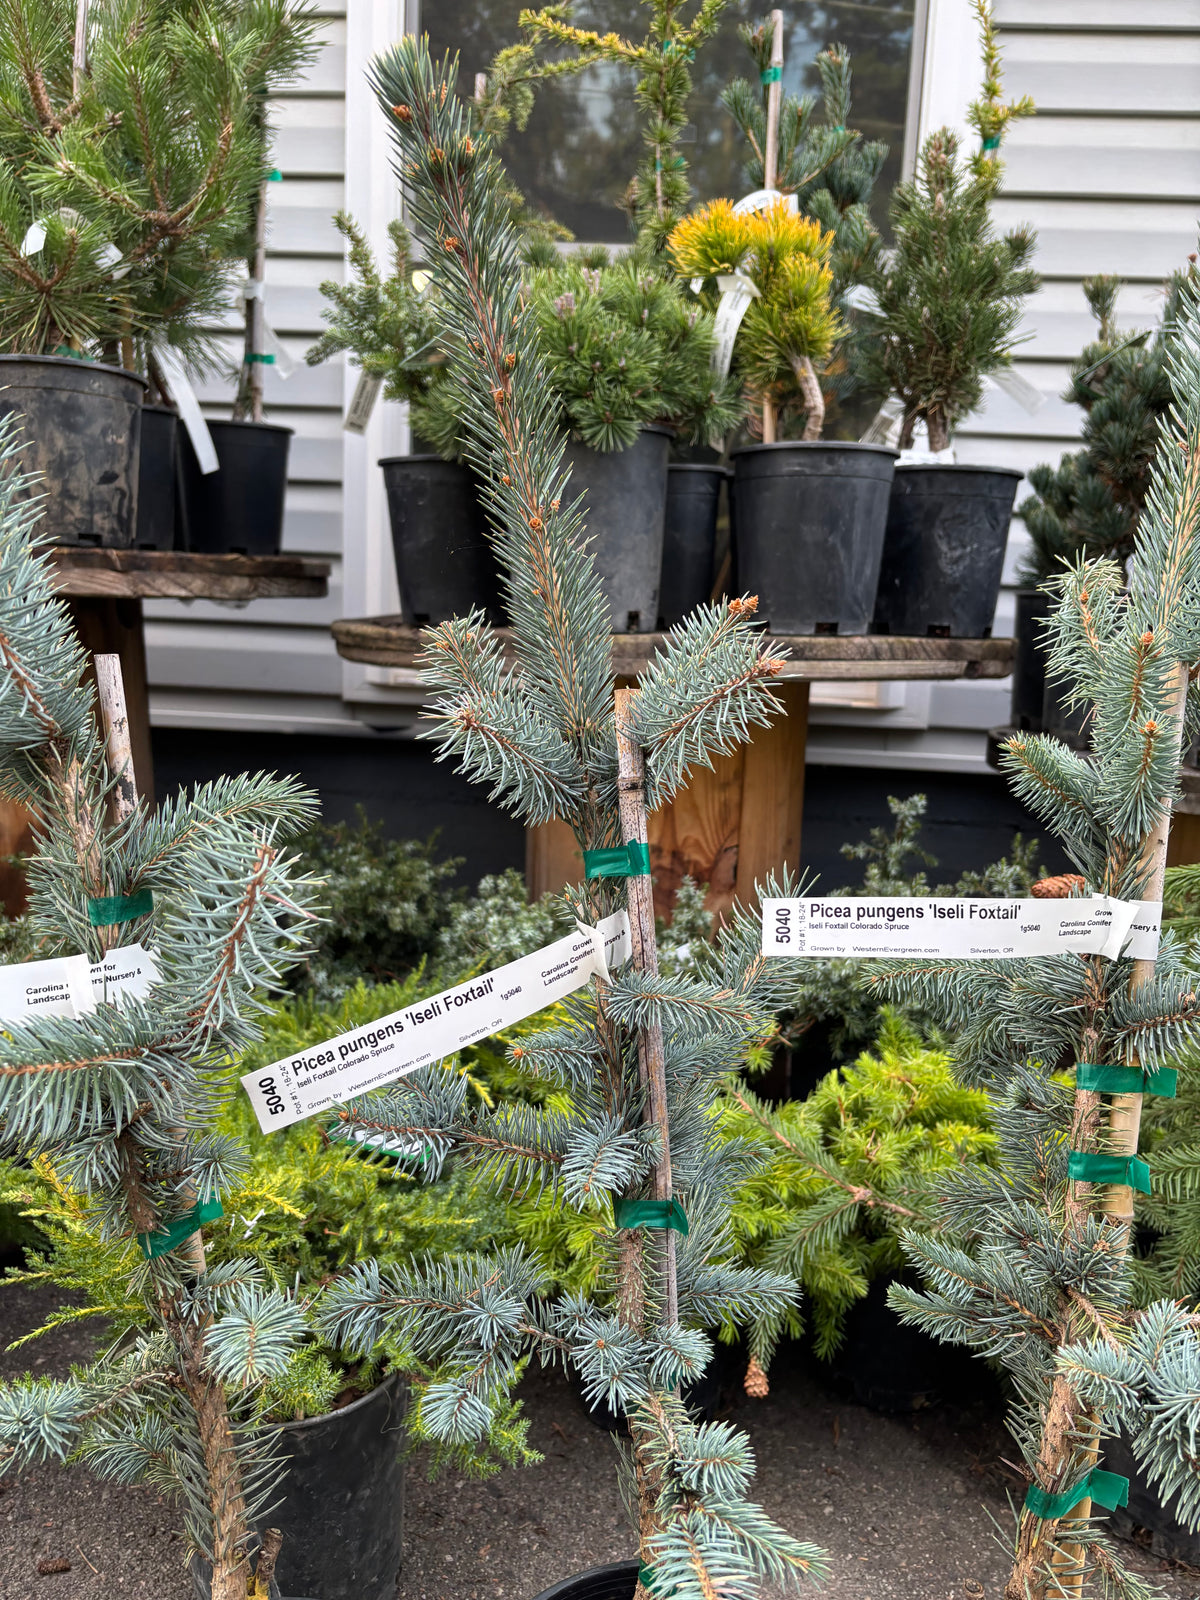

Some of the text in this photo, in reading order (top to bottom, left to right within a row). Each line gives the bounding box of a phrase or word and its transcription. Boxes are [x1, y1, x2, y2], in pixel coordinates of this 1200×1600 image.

[798, 902, 806, 924] 18-24"
[810, 903, 1021, 922] Picea pungens 'Iseli Foxtail'
[776, 908, 790, 944] 5040
[808, 922, 910, 932] Iseli Foxtail Colorado Spruce
[1020, 924, 1040, 933] 1g5040
[1060, 920, 1086, 928] Carolina
[1130, 924, 1149, 932] rsery
[798, 940, 806, 952] Pot
[852, 946, 940, 954] WesternEvergreen.com
[104, 963, 116, 972] for
[540, 961, 569, 978] Carolina
[543, 965, 578, 986] Landscape
[26, 984, 64, 995] Carolina
[106, 970, 136, 983] Nursery
[27, 993, 70, 1005] Landscap
[500, 986, 522, 1001] 1g5040
[291, 977, 494, 1076] Picea pungens 'Iseli Foxtail'
[458, 1018, 503, 1042] Silverton, OR
[296, 1042, 396, 1088] Iseli Foxtail Colorado Spruce
[307, 1052, 431, 1110] Grown by WesternEvergreen.com
[258, 1076, 285, 1115] 5040
[294, 1101, 303, 1114] Pot
